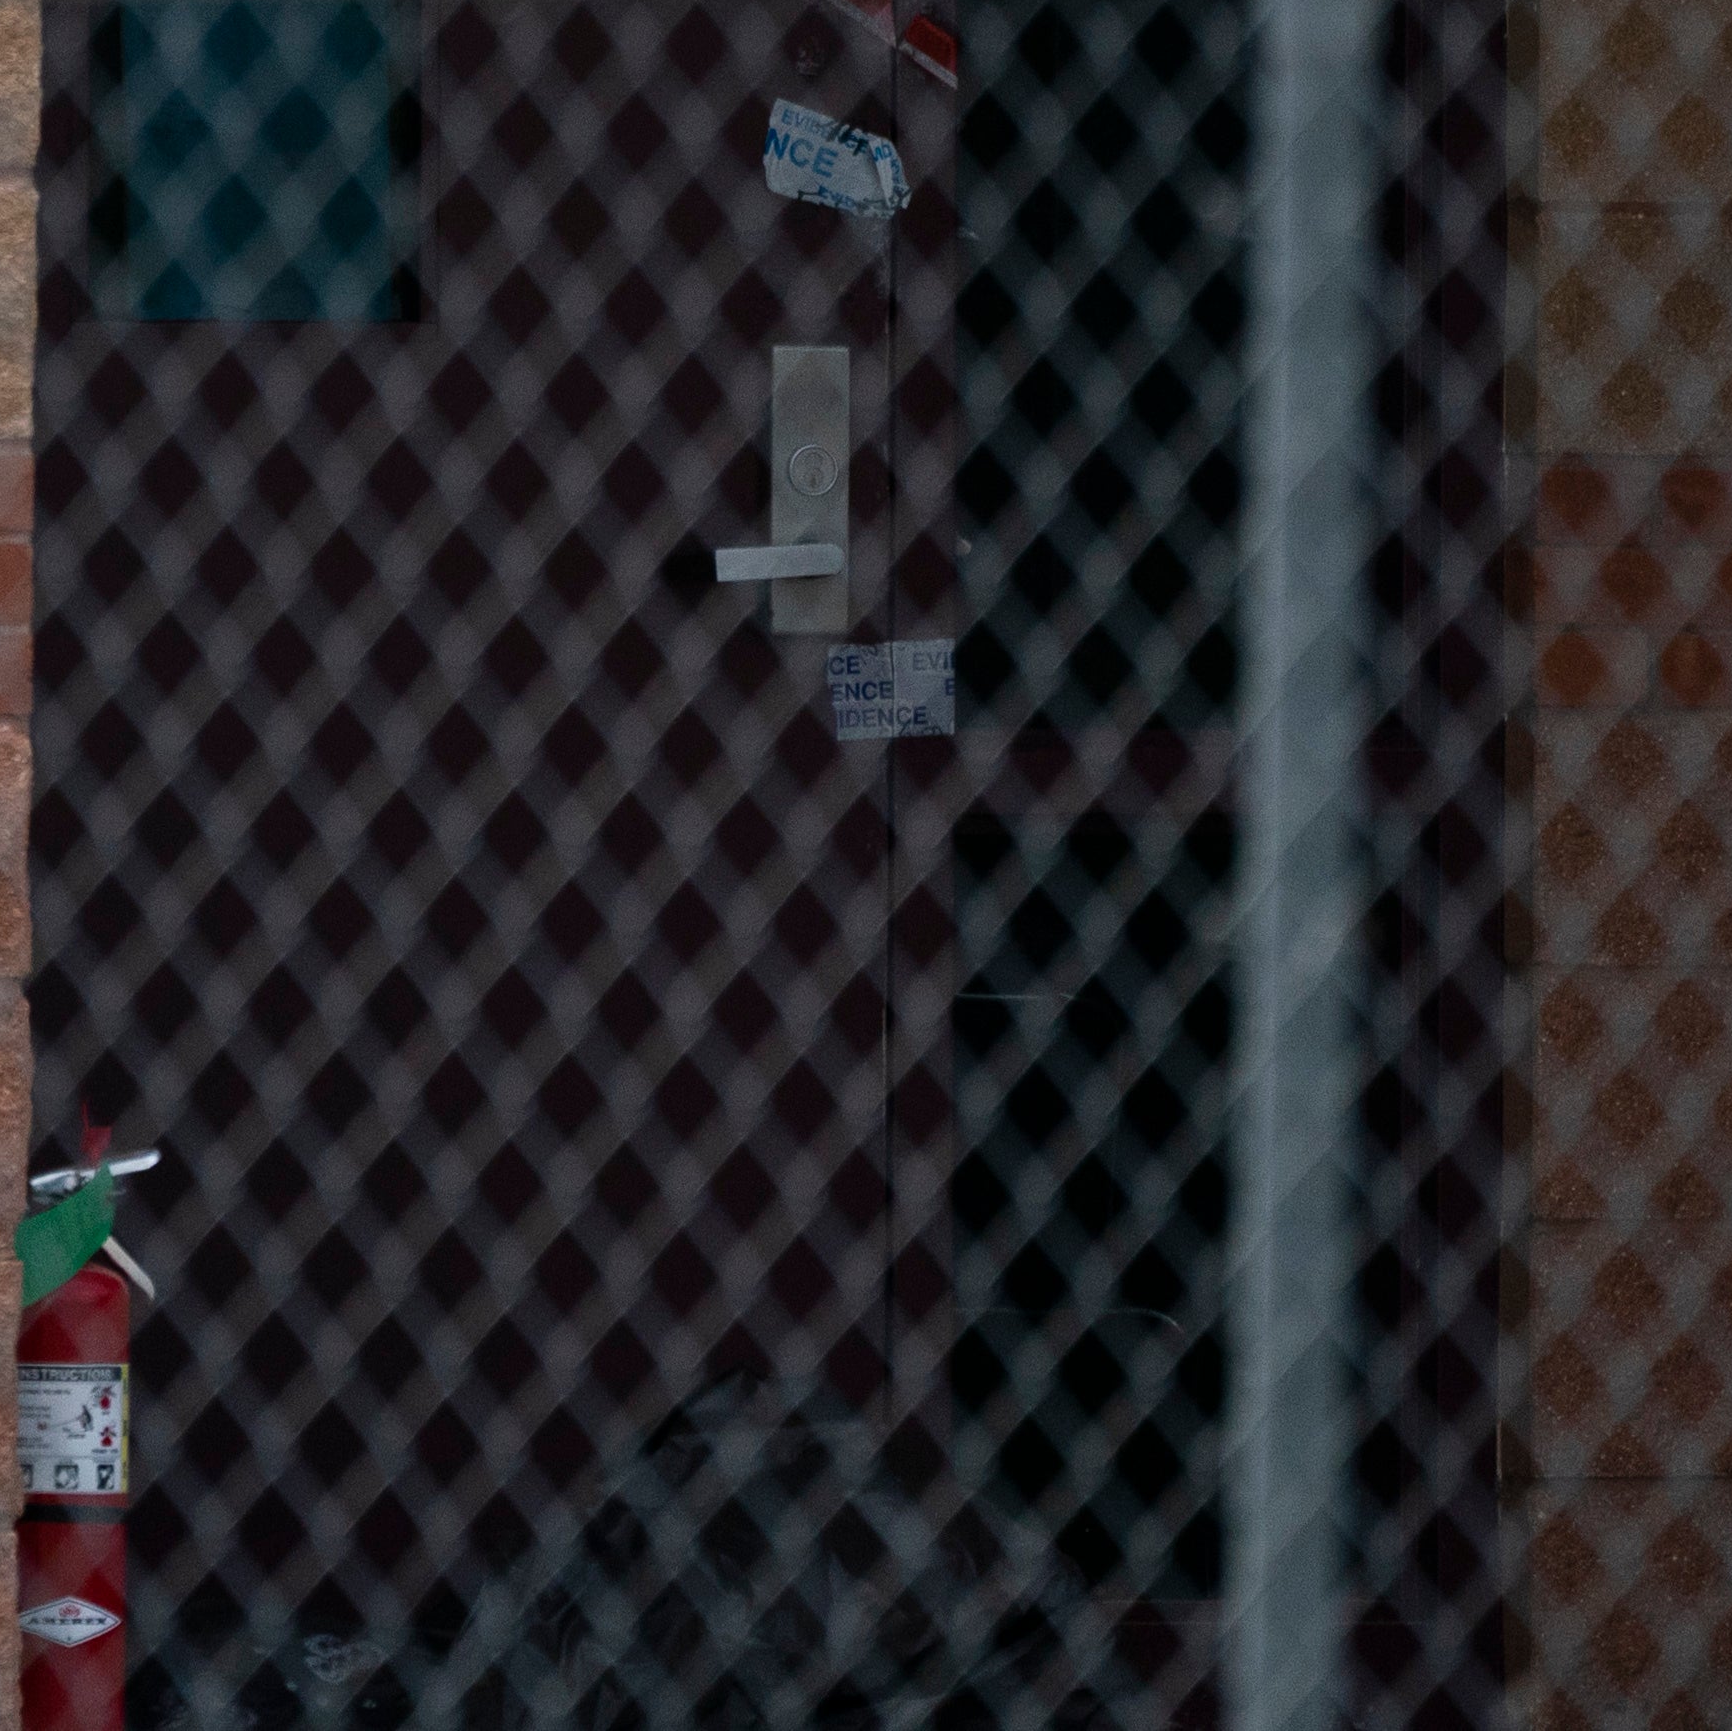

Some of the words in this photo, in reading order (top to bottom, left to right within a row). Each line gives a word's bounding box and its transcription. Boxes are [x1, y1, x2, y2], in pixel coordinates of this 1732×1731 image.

[763, 128, 838, 178] NCE
[829, 655, 861, 676] CE
[831, 680, 894, 701] ENCE
[837, 705, 929, 729] IDENCE
